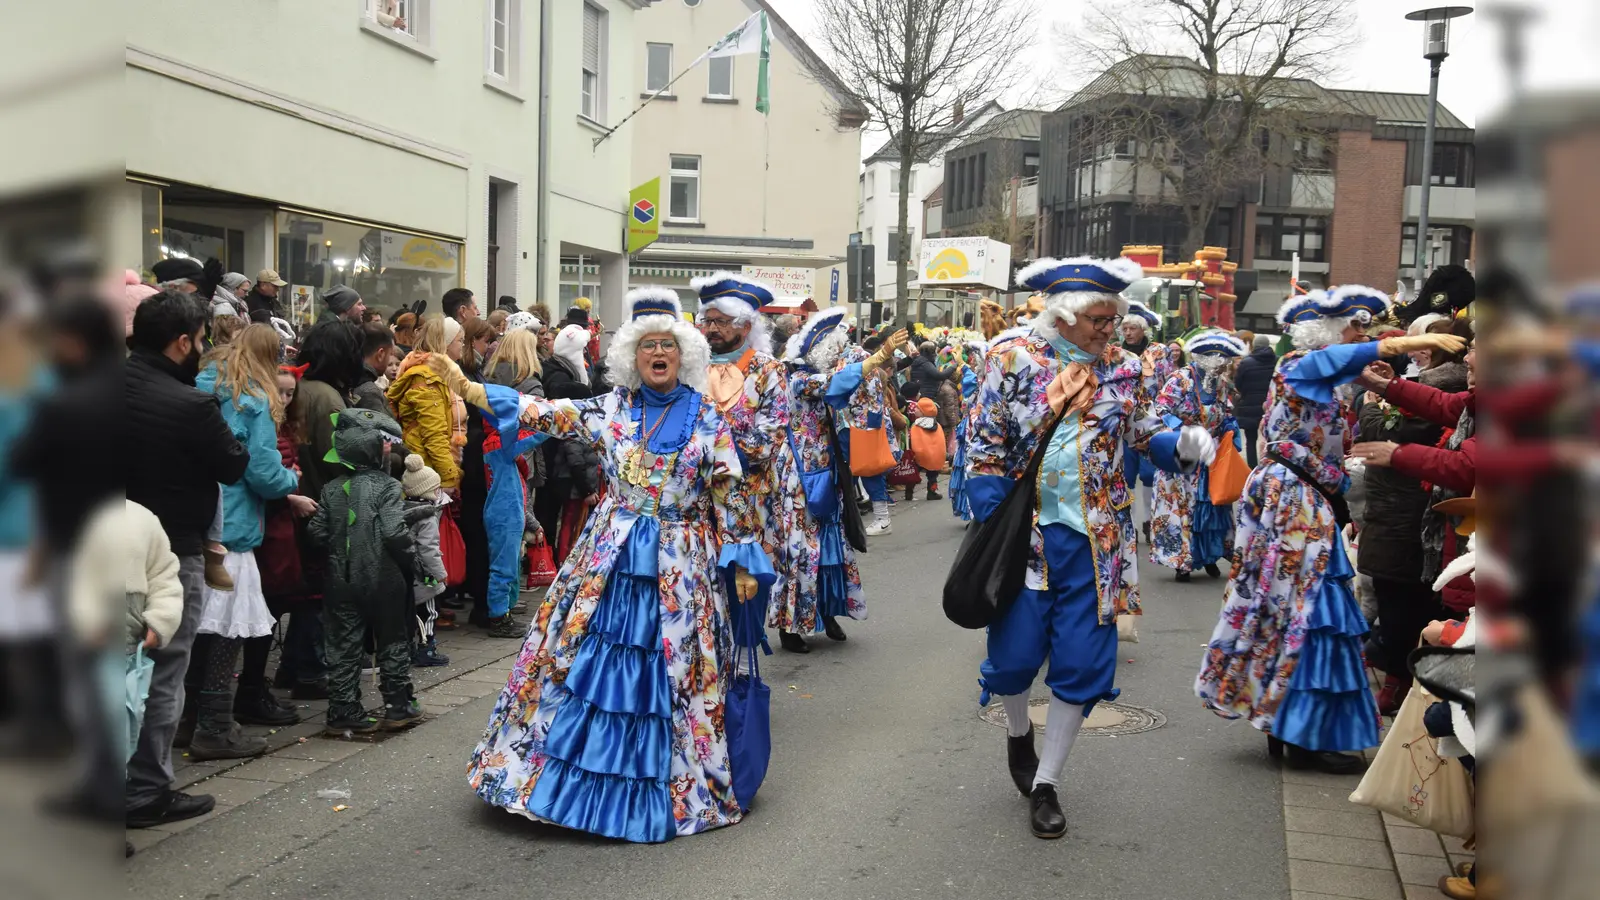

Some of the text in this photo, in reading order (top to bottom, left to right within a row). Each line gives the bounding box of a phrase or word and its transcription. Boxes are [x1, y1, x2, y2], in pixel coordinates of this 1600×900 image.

[977, 249, 985, 257] 25
[754, 268, 806, 280] Freunde des
